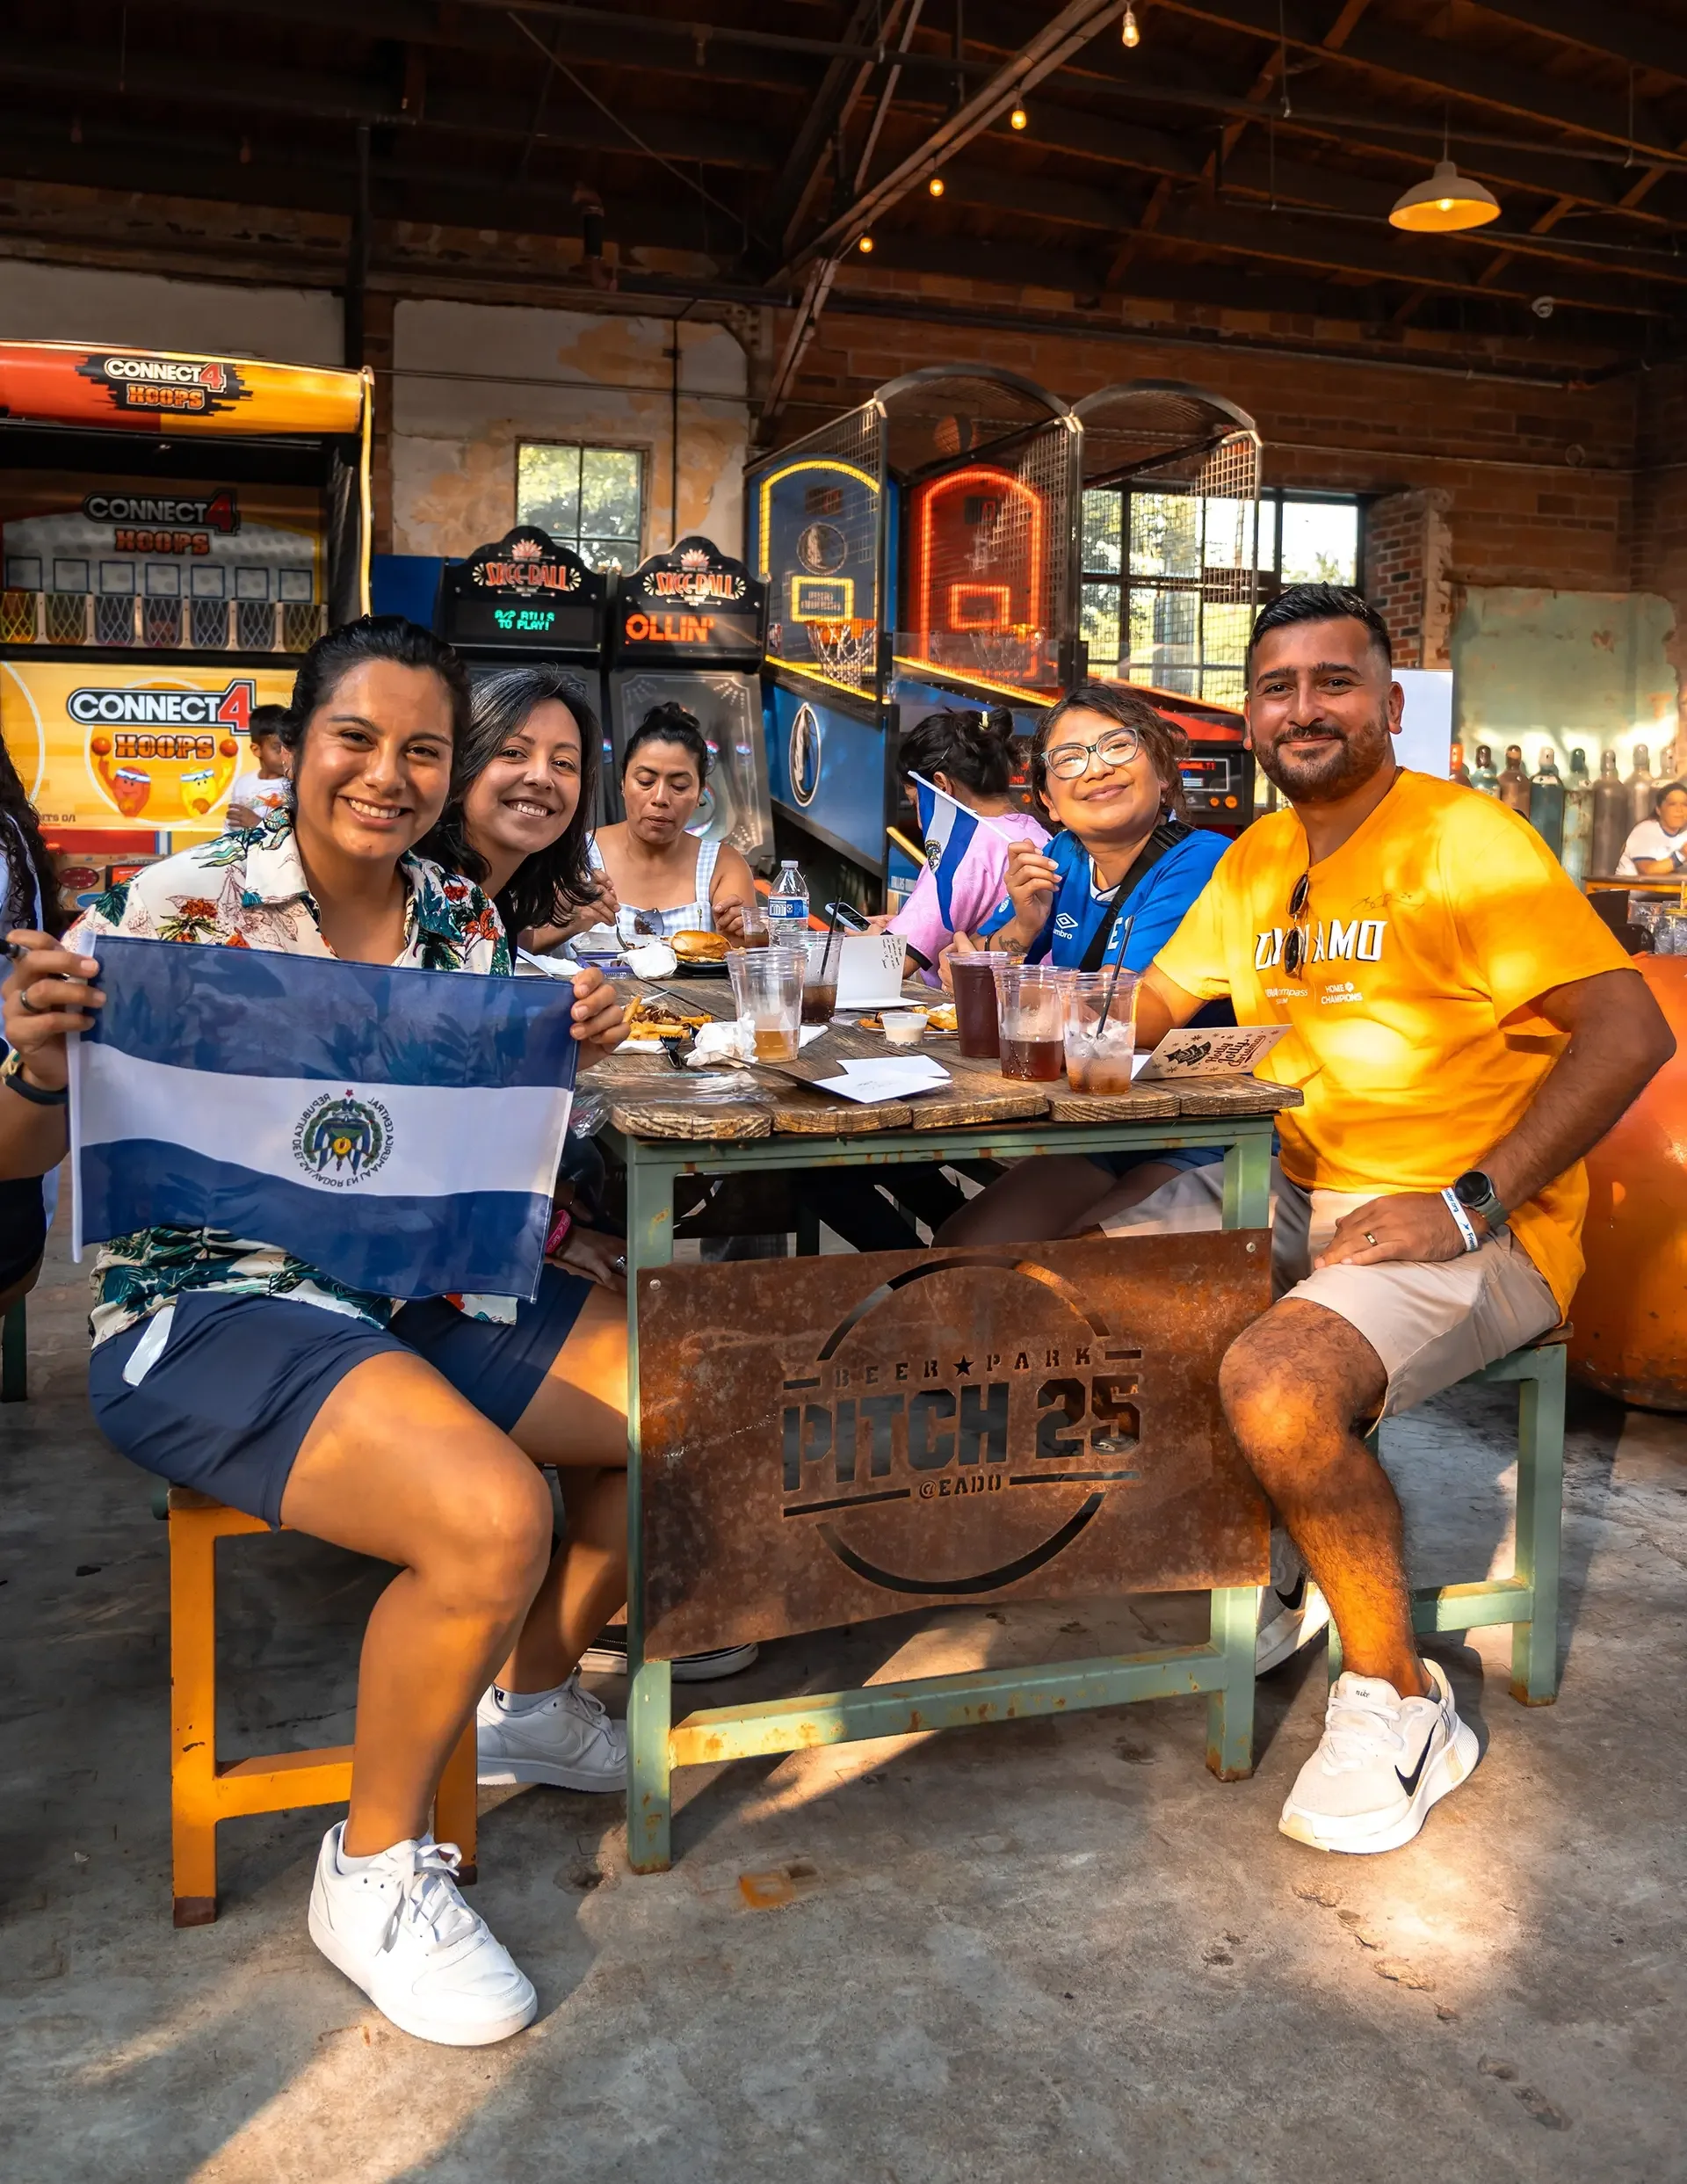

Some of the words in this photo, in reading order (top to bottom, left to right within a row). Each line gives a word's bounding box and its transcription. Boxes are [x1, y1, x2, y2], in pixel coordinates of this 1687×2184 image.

[105, 357, 201, 384] CONNECT
[199, 362, 225, 390] 4
[126, 384, 205, 410] HOOPS
[88, 495, 207, 525] CONNECT
[205, 492, 239, 534] 4
[114, 529, 210, 555] HOOPS
[497, 619, 513, 629] TO
[517, 619, 550, 631] PLAY!
[70, 691, 220, 723] CONNECT
[217, 684, 252, 731] 4
[114, 733, 215, 760] HOOPS
[1321, 992, 1363, 1005] CHAMPIONS
[836, 1360, 938, 1388] BEER
[986, 1346, 1091, 1372] PARK
[782, 1382, 1010, 1492] PITCH
[1035, 1375, 1140, 1459] 25
[918, 1474, 1002, 1498] @EADO
